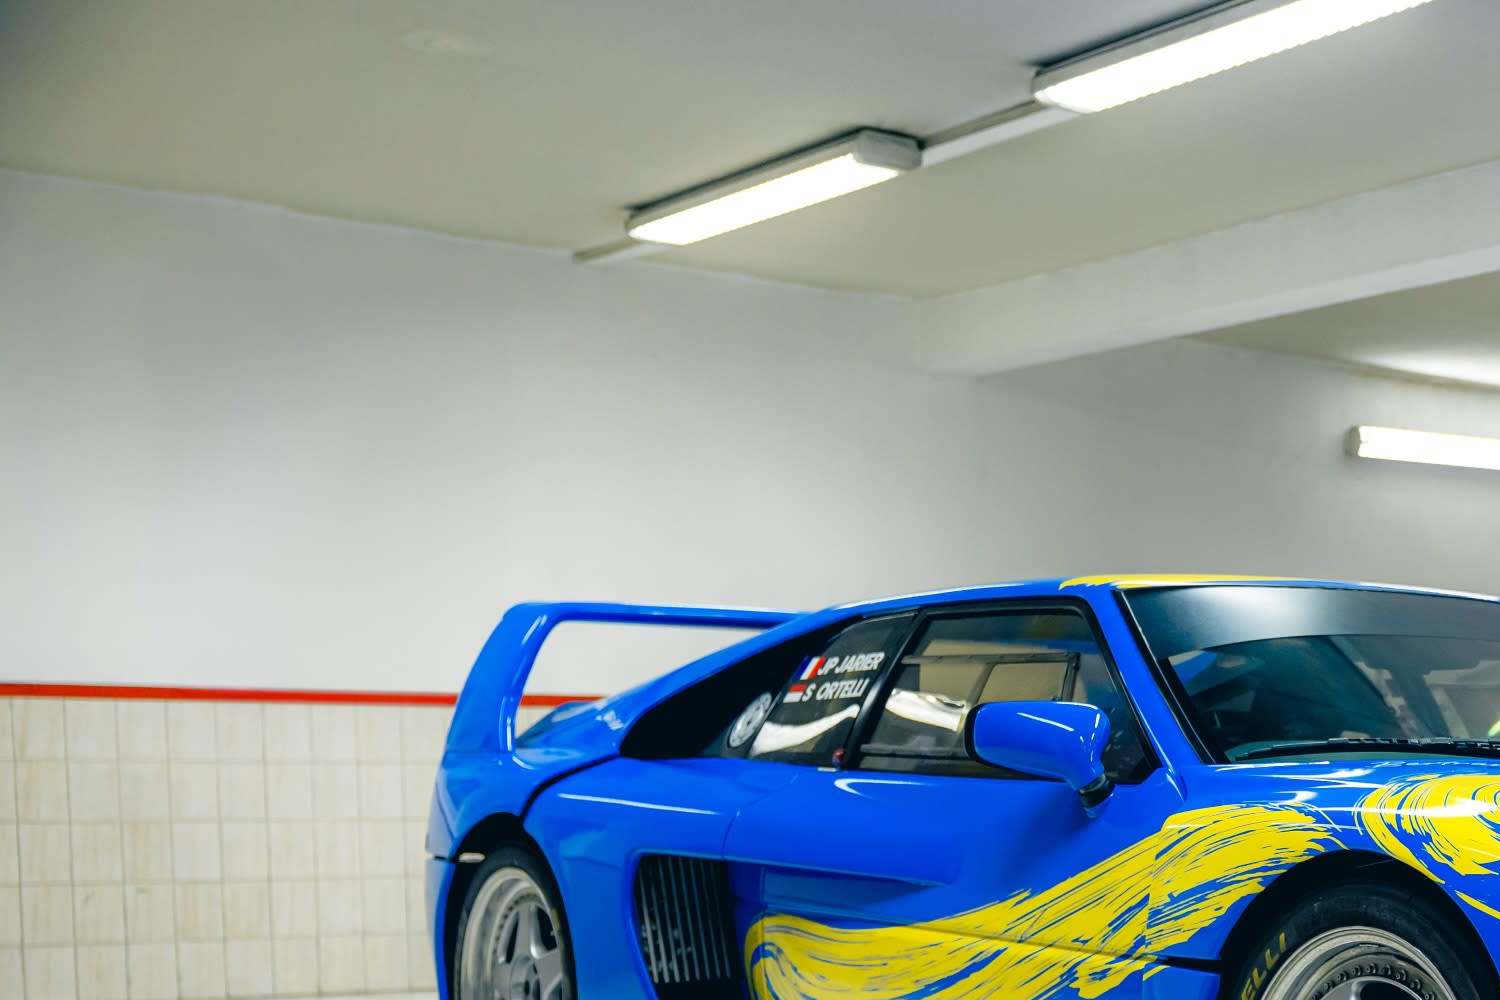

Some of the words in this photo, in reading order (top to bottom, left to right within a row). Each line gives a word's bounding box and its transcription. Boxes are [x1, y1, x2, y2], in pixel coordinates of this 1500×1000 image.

[834, 651, 885, 674] JARIER
[801, 682, 817, 702] S
[815, 677, 870, 700] ORTELLI
